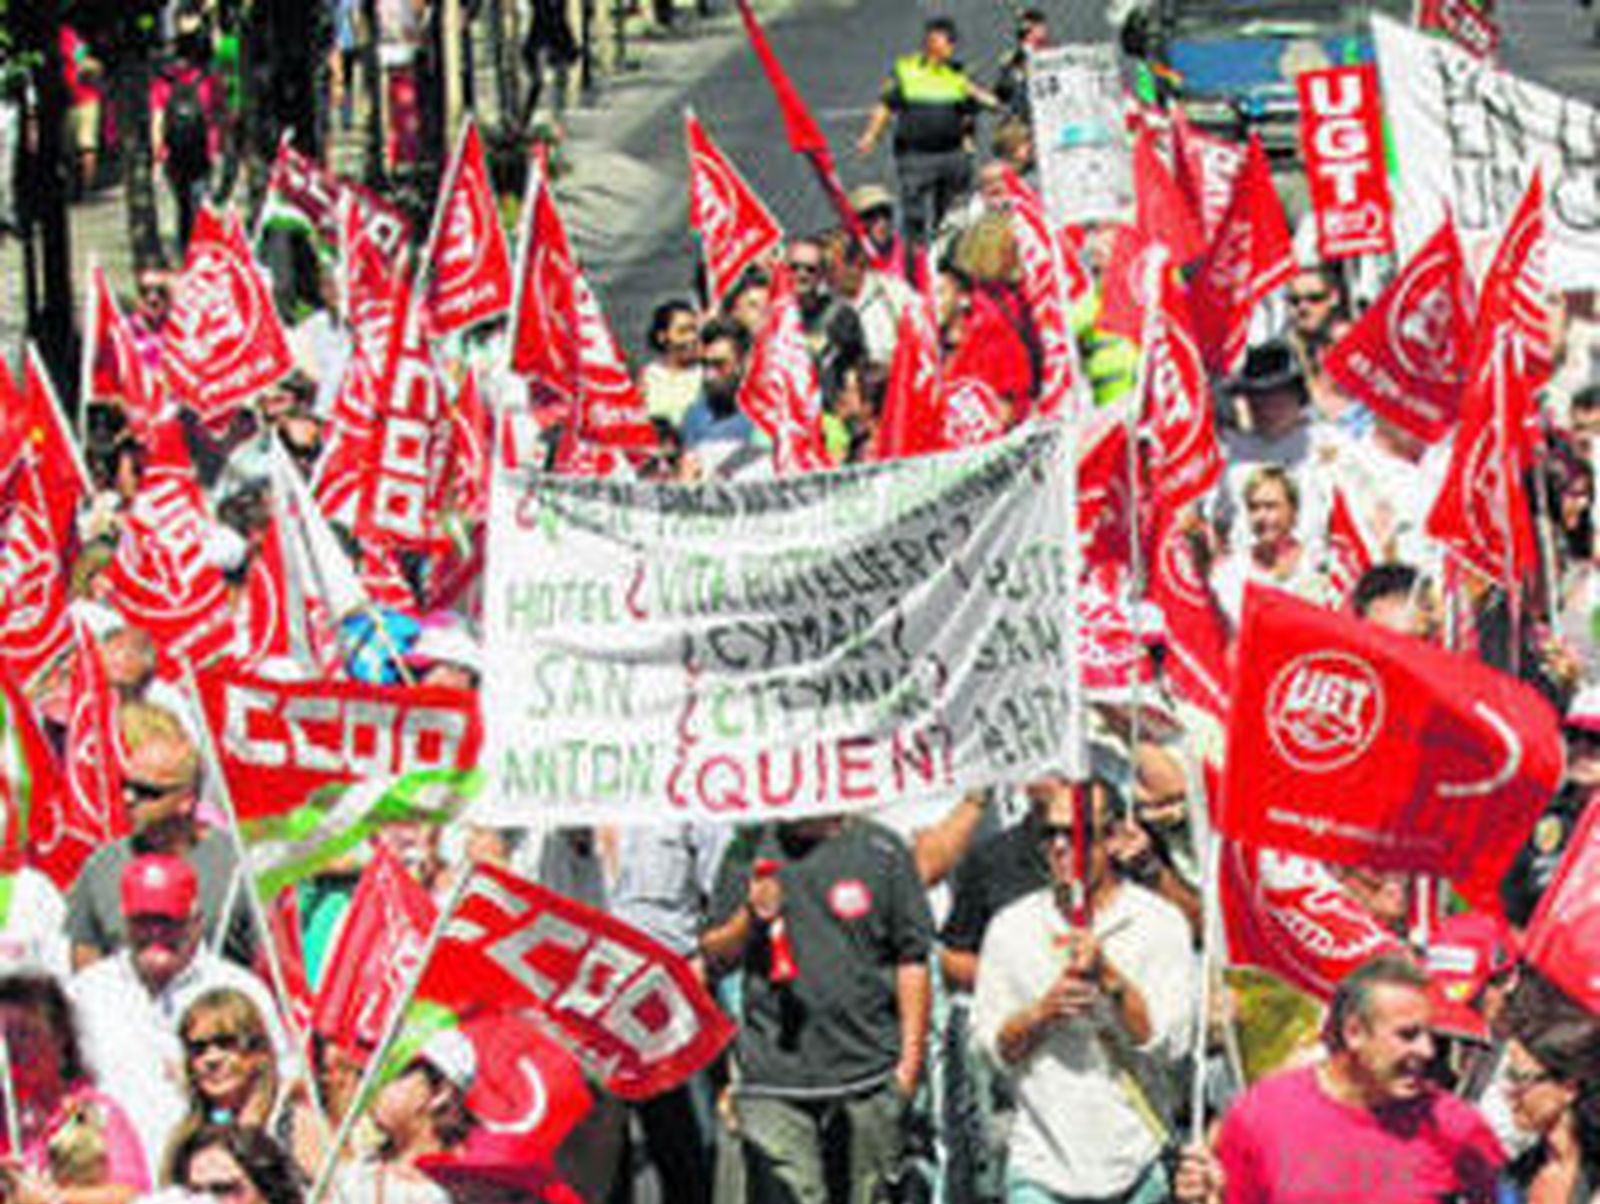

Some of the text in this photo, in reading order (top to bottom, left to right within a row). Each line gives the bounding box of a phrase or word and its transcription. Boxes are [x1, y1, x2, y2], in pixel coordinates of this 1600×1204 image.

[1309, 75, 1371, 203] UGT
[505, 578, 616, 631] HOTEL
[528, 650, 633, 719] SAN
[1286, 665, 1370, 726] UGT
[222, 685, 468, 780] CCOO
[500, 738, 655, 798] ANTON
